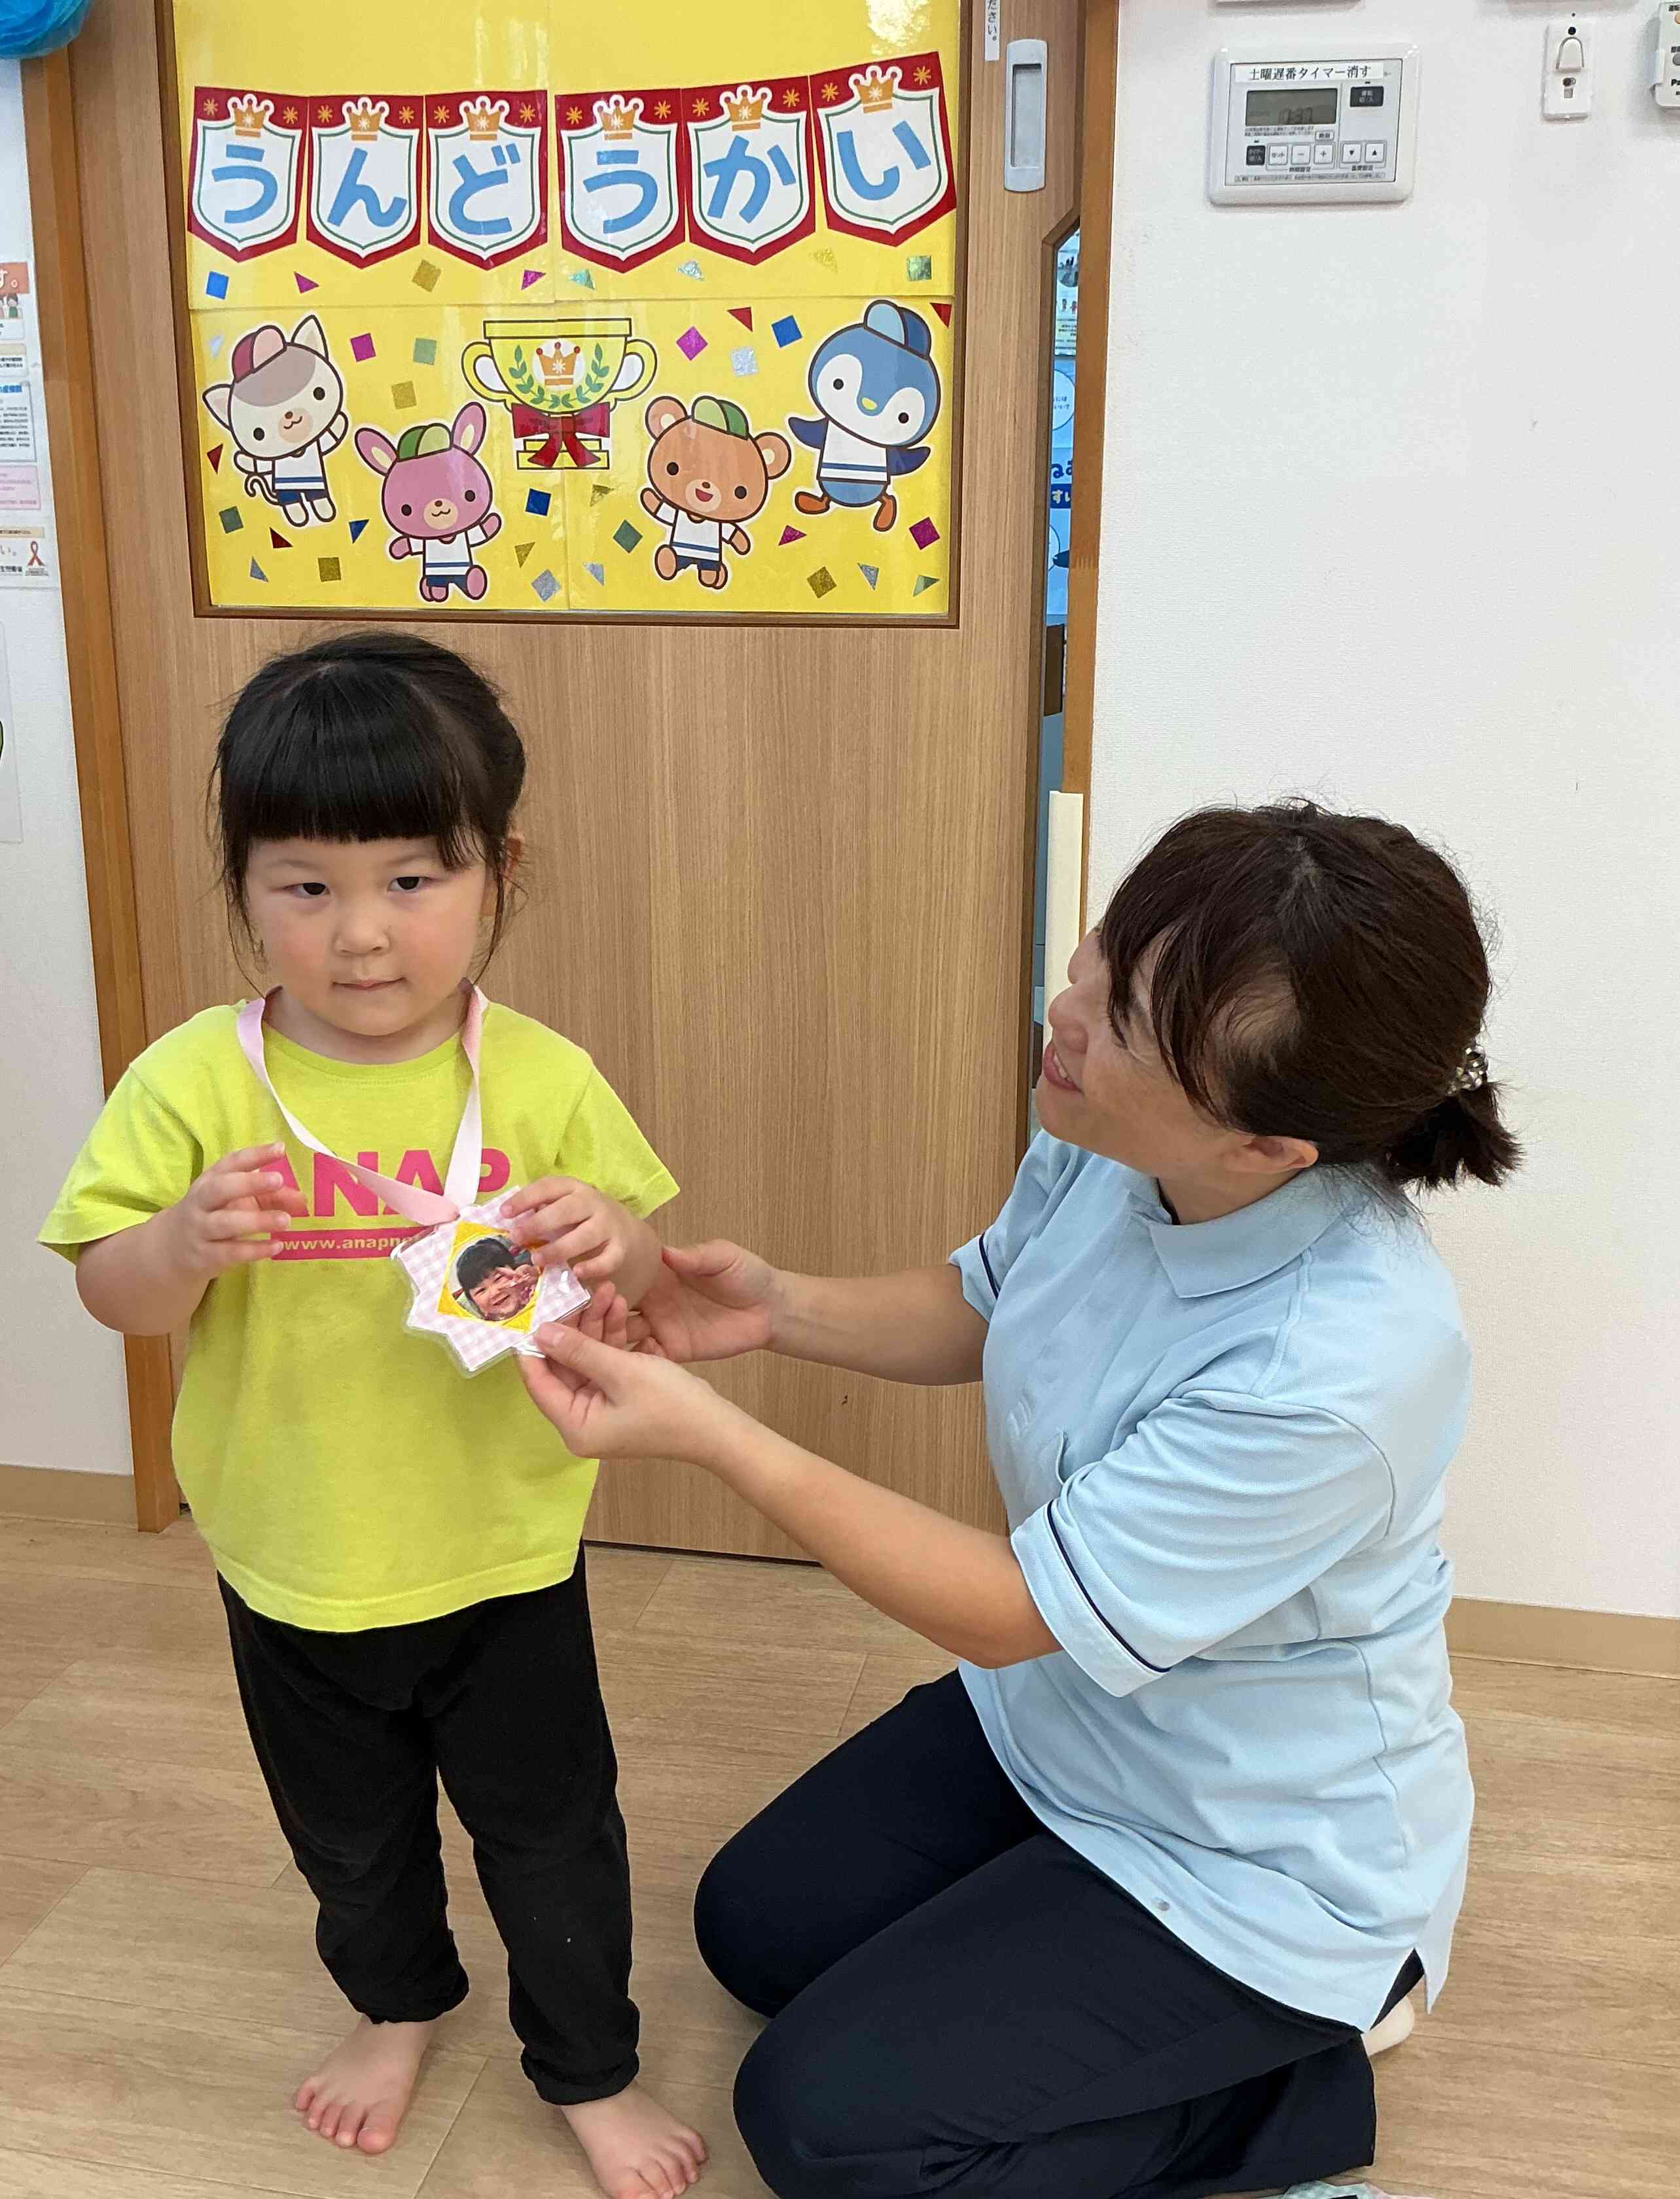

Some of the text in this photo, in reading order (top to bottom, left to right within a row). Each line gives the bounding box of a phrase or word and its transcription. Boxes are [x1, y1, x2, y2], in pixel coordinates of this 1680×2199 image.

[1250, 65, 1372, 81] 土曜遅番タイマー消す
[211, 121, 930, 235] うんどうかい
